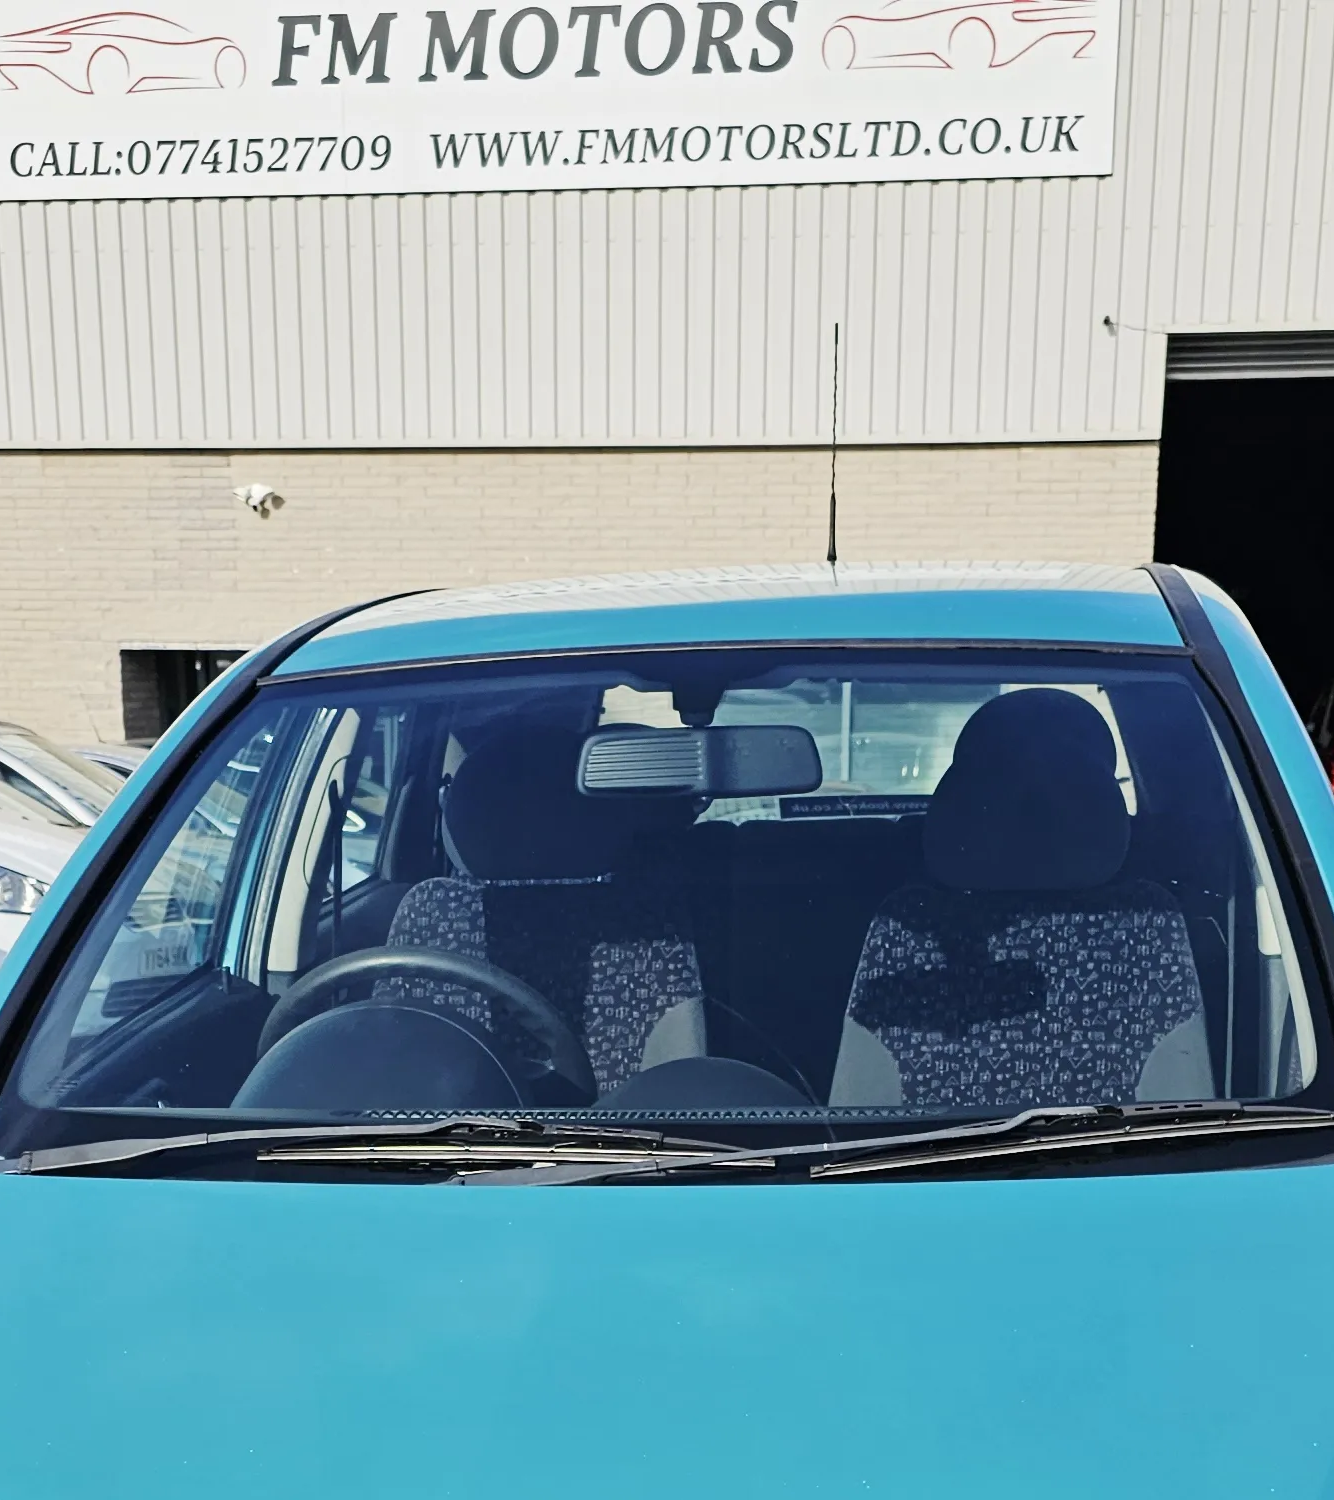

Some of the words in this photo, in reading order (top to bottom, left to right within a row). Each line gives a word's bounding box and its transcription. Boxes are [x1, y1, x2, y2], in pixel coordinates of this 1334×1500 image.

[271, 12, 398, 86] FM
[418, 0, 798, 82] MOTORS
[9, 134, 392, 178] CALL:07741527709
[429, 114, 1085, 169] WWW.FMMOTORSLTD.CO.UK
